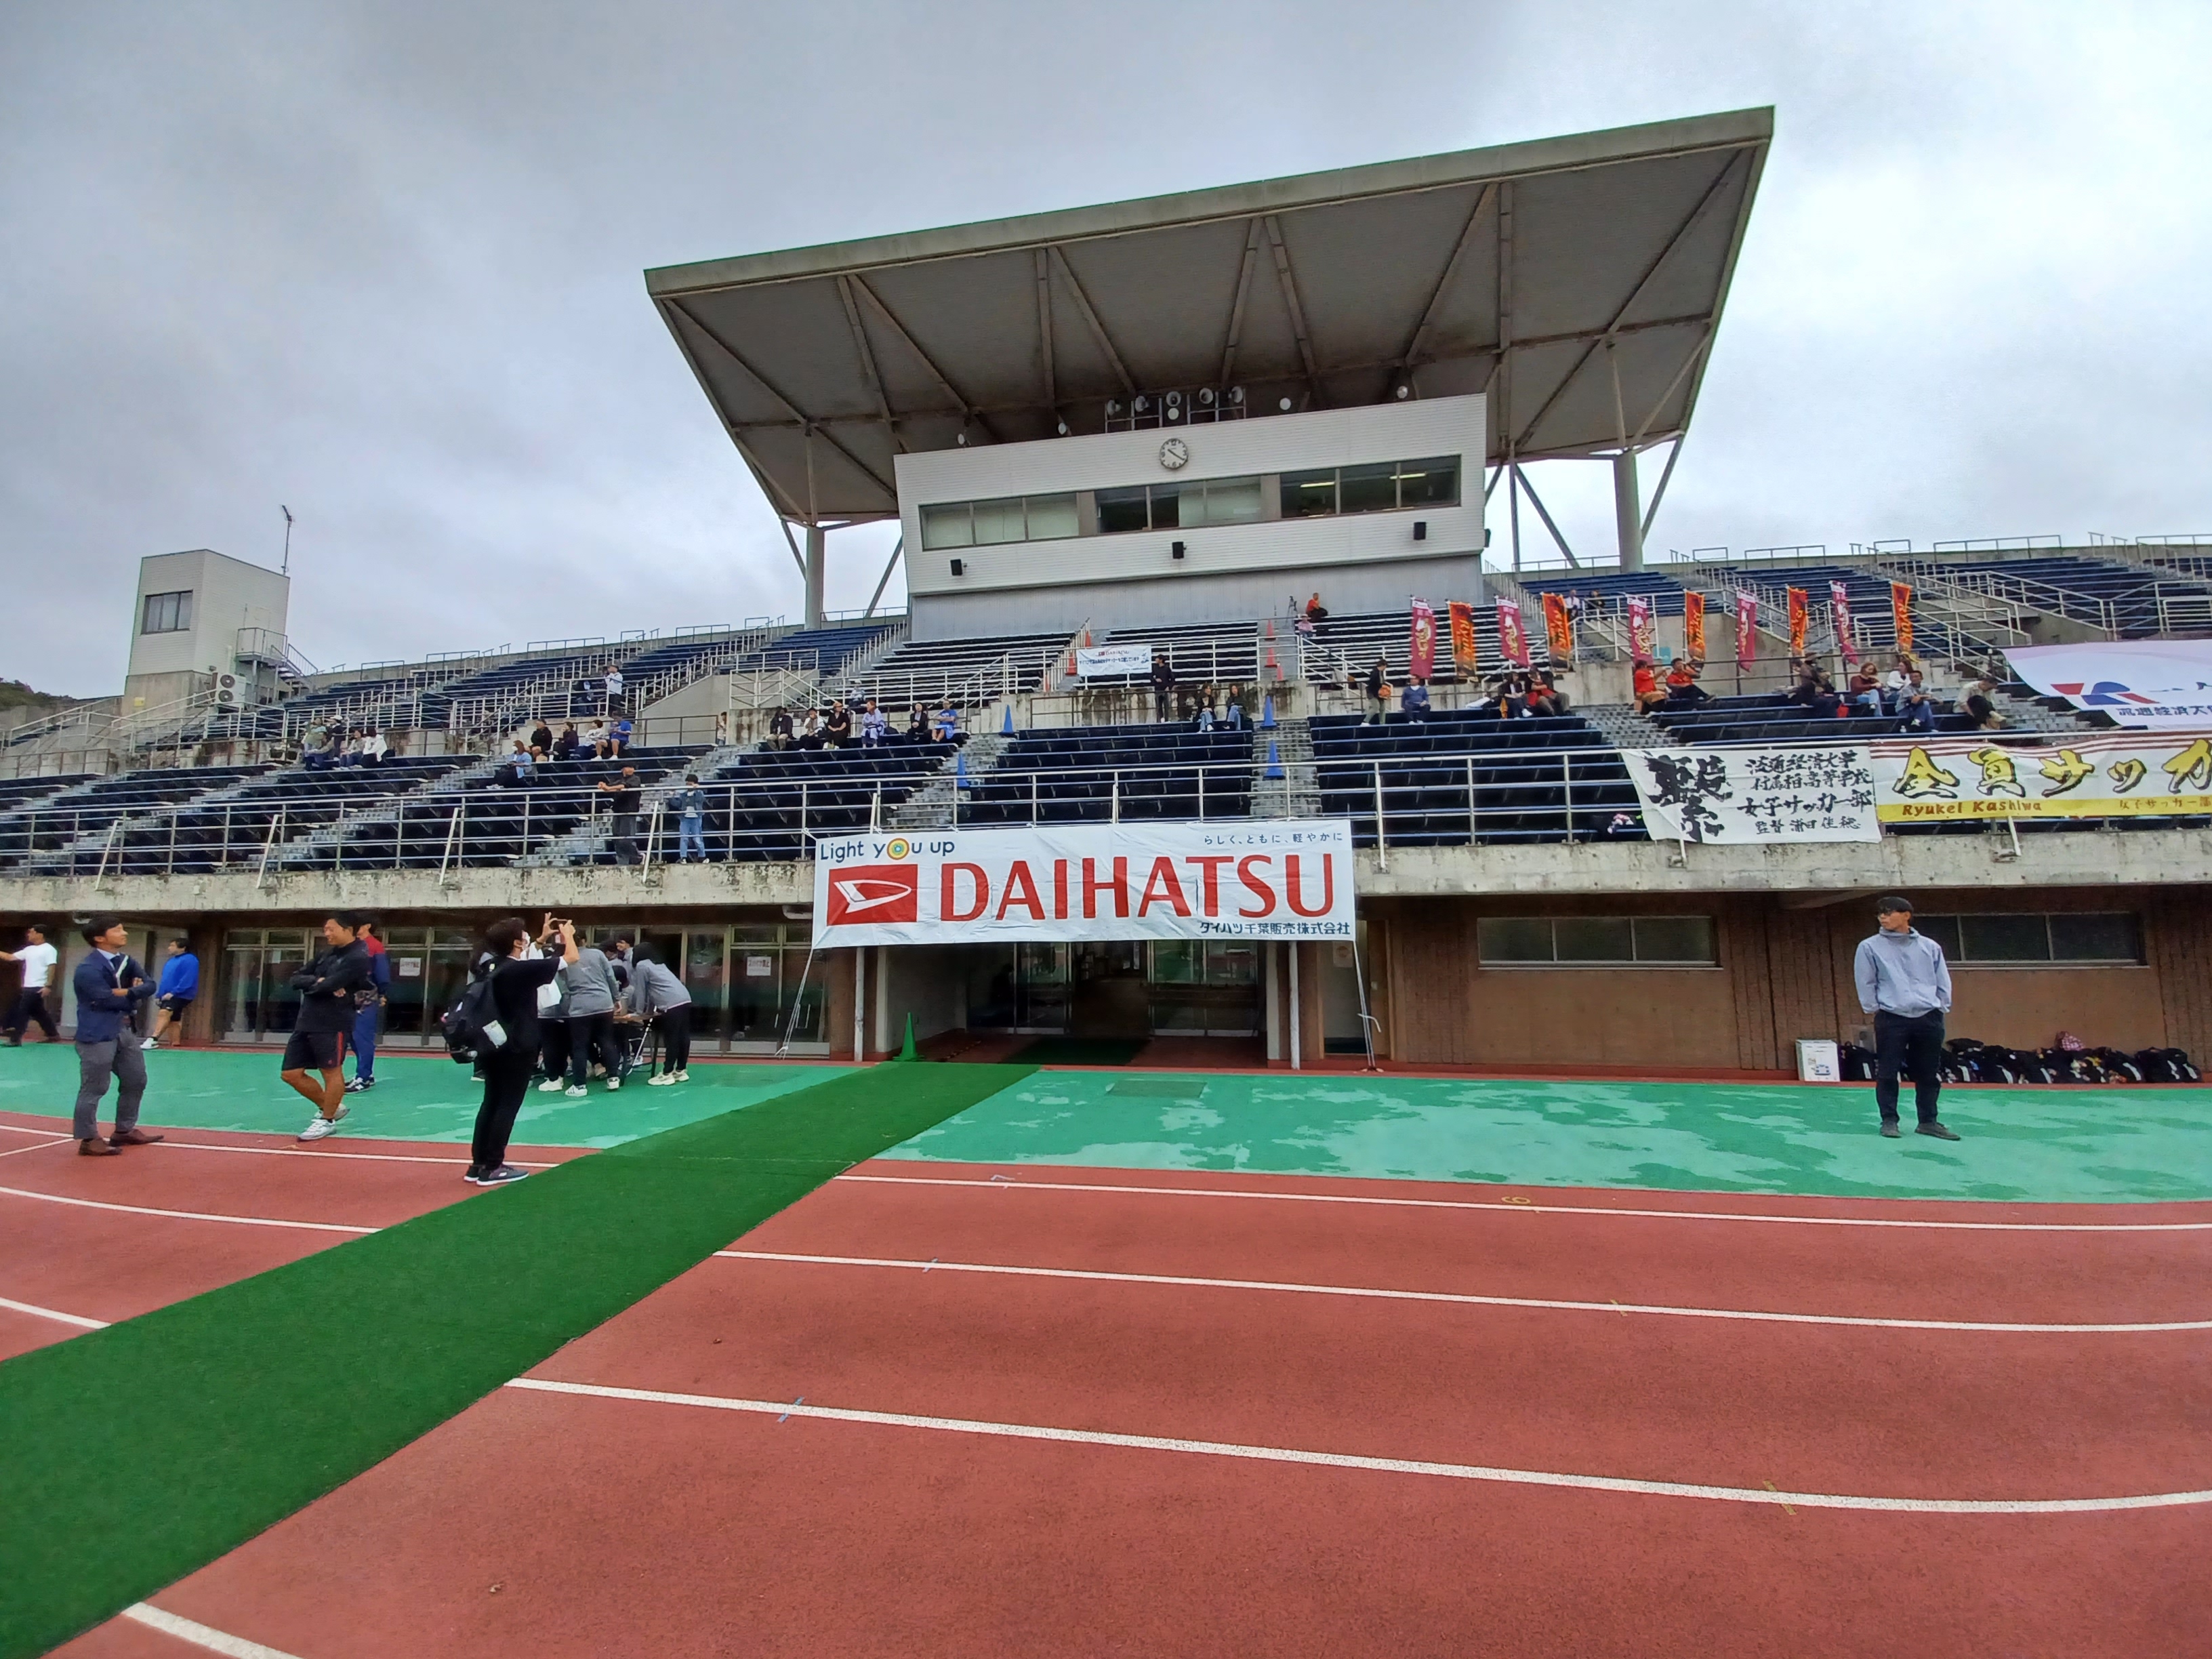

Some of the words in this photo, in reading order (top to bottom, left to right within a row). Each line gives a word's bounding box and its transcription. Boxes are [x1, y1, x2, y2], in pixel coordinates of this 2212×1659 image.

[1204, 832, 1343, 845] らしく、ともに、軽やかに
[821, 841, 864, 863] Light
[930, 841, 955, 857] up
[941, 853, 1334, 922] DAIHATSU
[1200, 922, 1351, 935] ダイハツ千葉販売株式会社
